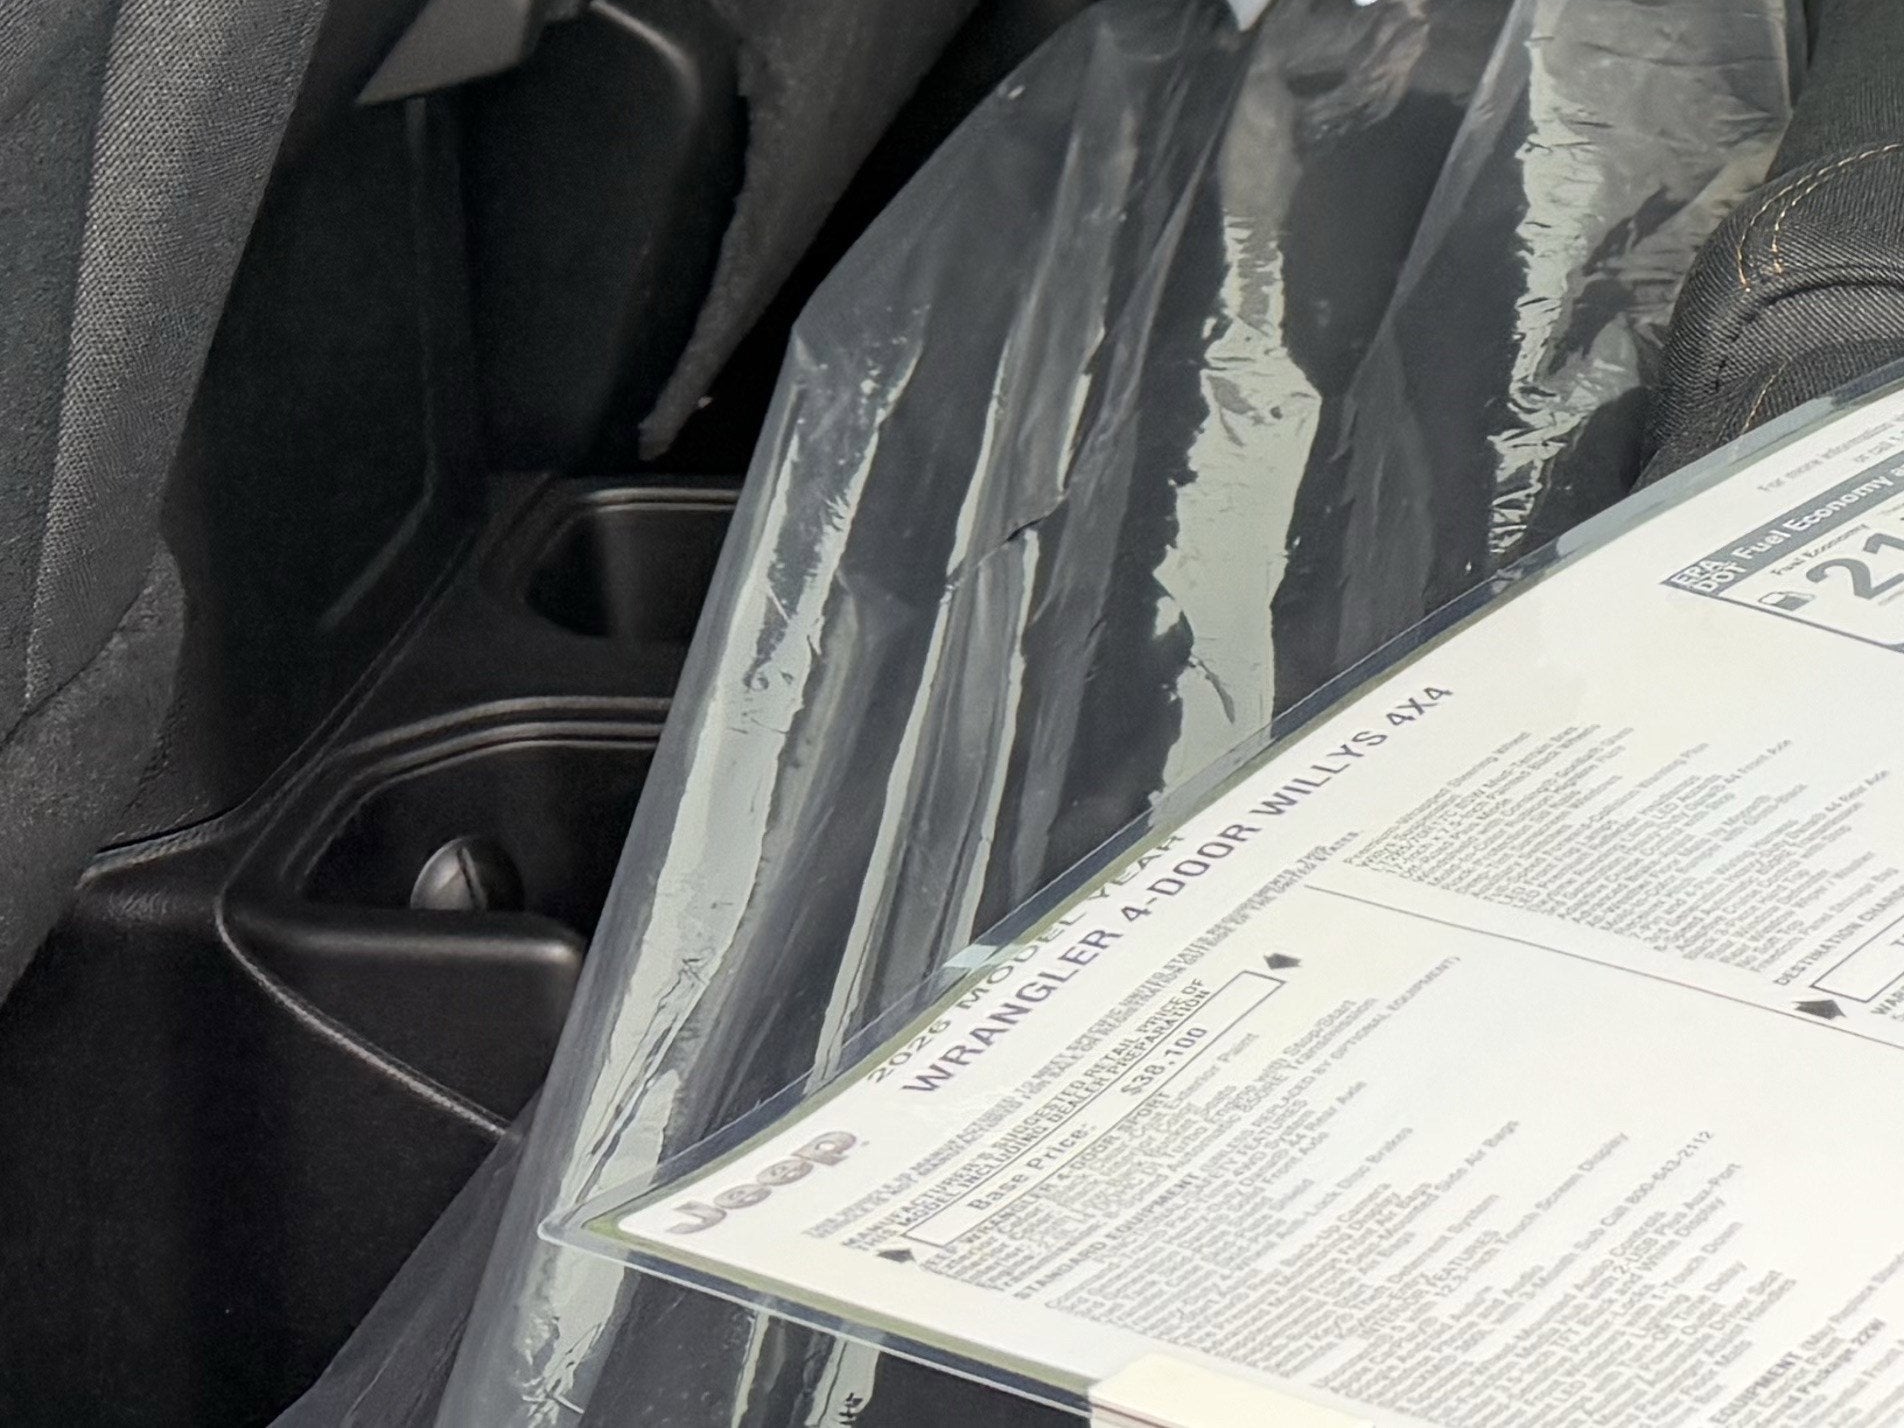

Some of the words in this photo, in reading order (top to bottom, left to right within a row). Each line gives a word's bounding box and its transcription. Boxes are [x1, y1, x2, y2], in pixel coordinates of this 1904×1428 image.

[1729, 528, 1793, 561] Fuel
[1781, 473, 1898, 532] Economy
[1668, 556, 1725, 587] EPA
[1690, 561, 1750, 593] DOT
[893, 925, 1126, 1096] WRANGLER
[1111, 820, 1264, 923] 4-DOOR
[1248, 727, 1391, 821] WILLYS
[1379, 683, 1455, 728] 4X4
[863, 1018, 955, 1083] 2026
[954, 908, 1089, 1010] MODEL
[1770, 921, 1865, 986] DESTINATION
[988, 1079, 1089, 1149] SUGGESTED
[1081, 1033, 1141, 1079] RETAIL
[1132, 995, 1187, 1034] PRICE
[1179, 977, 1209, 995] OF
[964, 1171, 1030, 1211] Base
[1020, 1121, 1099, 1171] Price:
[1115, 1025, 1212, 1097] $38,100
[665, 1131, 857, 1234] Jeep
[1103, 1171, 1205, 1240] EQUIPMENT
[1705, 1351, 1805, 1424] EQUIPMENT
